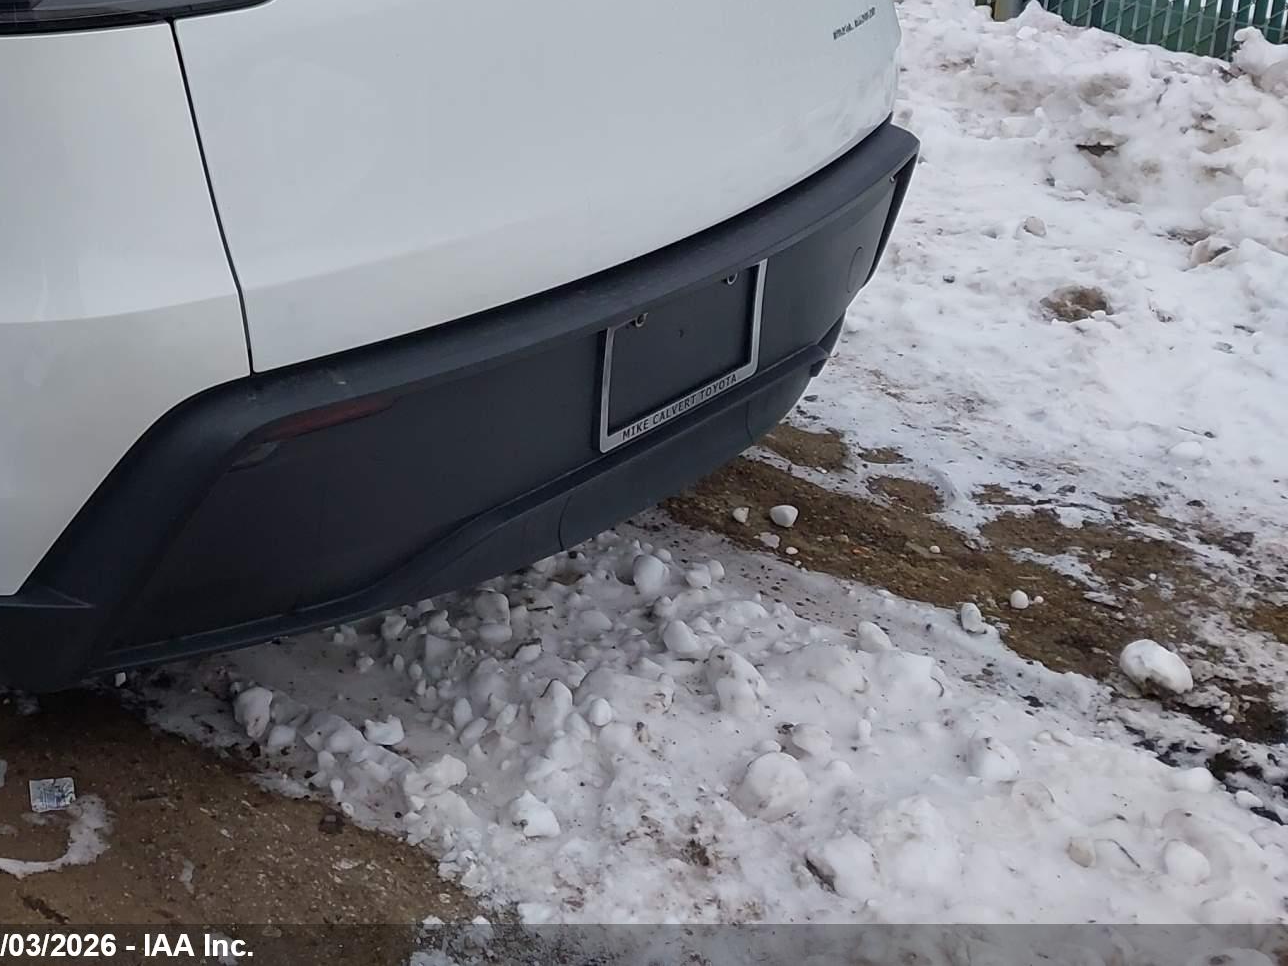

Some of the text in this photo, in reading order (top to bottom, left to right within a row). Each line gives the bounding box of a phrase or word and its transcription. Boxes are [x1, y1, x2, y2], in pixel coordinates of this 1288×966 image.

[622, 374, 737, 440] MIKE CALVERT TOYOTA
